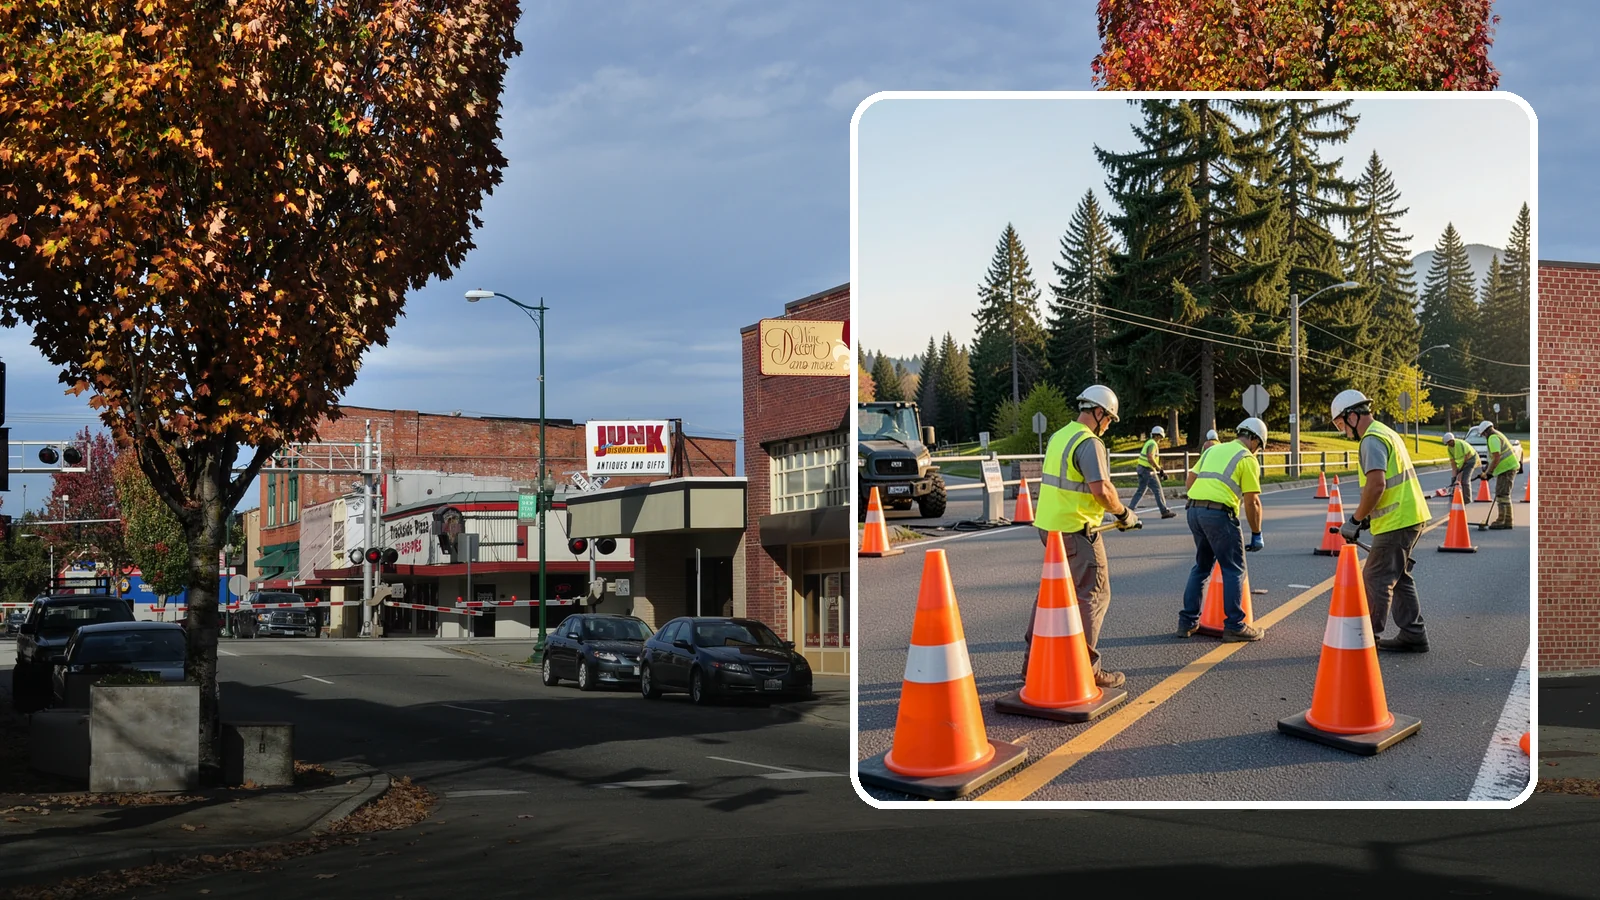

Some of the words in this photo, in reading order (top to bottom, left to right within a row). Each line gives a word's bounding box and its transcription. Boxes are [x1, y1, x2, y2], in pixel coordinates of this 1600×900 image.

[765, 328, 831, 365] Decor
[595, 425, 665, 457] JUNK
[597, 461, 628, 470] ANTIQUES
[631, 461, 644, 470] AND
[647, 461, 665, 469] GIFTS
[588, 476, 608, 492] SING
[390, 521, 413, 540] Trackside
[414, 519, 429, 535] Pizza
